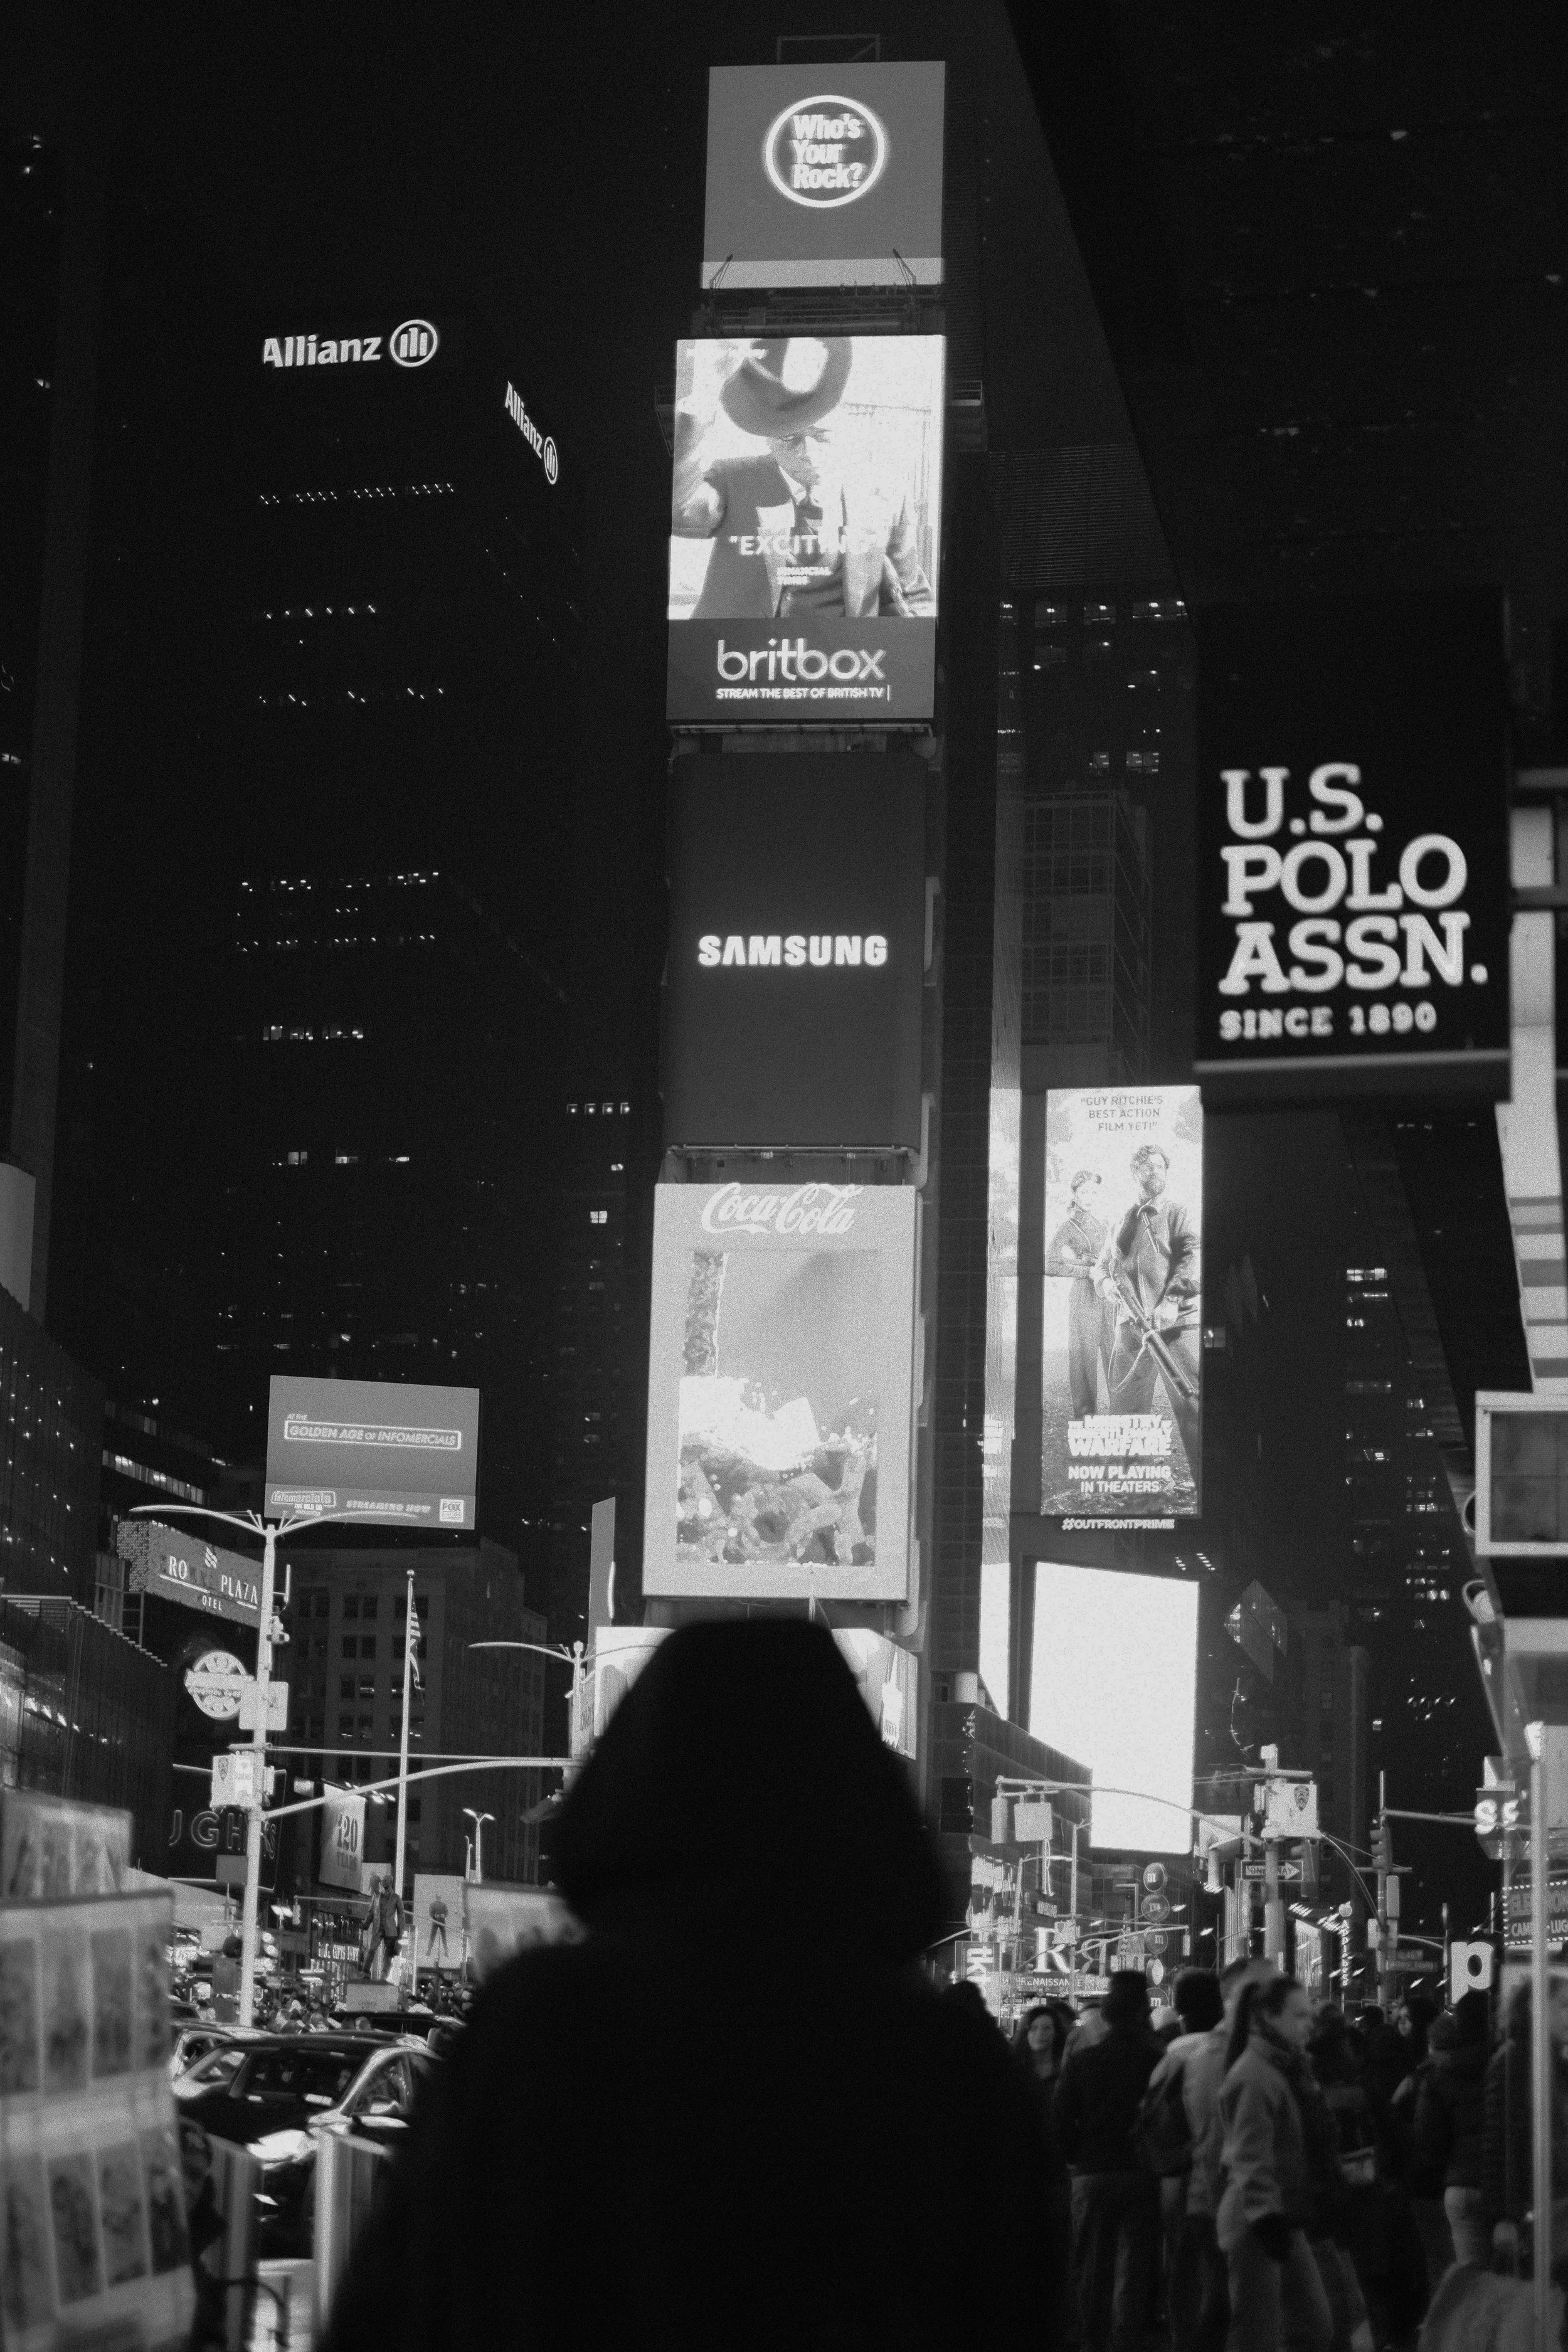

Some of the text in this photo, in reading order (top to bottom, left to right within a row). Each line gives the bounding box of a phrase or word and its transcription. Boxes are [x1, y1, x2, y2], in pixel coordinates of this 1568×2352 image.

[793, 114, 861, 139] Who's
[791, 139, 844, 164] Your
[793, 162, 864, 189] Rock?
[263, 334, 381, 368] Allianz
[505, 381, 543, 458] Allianz
[717, 637, 886, 681] britbox
[716, 687, 884, 699] STREAM THE BEST OF BRITISH TV
[1220, 763, 1383, 839] U.S.
[1220, 834, 1468, 916] POLO
[698, 935, 888, 966] SAMSUNG
[1217, 911, 1488, 995] ASSN.
[1219, 1001, 1437, 1041] SINCE 1890
[1111, 1095, 1163, 1105] RITCHIE'S
[1089, 1108, 1161, 1119] BEST ACTION
[1098, 1122, 1125, 1131] FILM
[701, 1181, 864, 1234] Coca-Cola
[290, 1425, 337, 1438] GOLDEN
[339, 1428, 363, 1440] AGE
[378, 1431, 456, 1446] INFOMERCIALS
[1068, 1465, 1172, 1480] NOW PLAYING
[1081, 1481, 1160, 1493] IN THEATERS
[442, 1503, 461, 1511] FOX
[1062, 1518, 1175, 1530] #OUTFRONTPRIME
